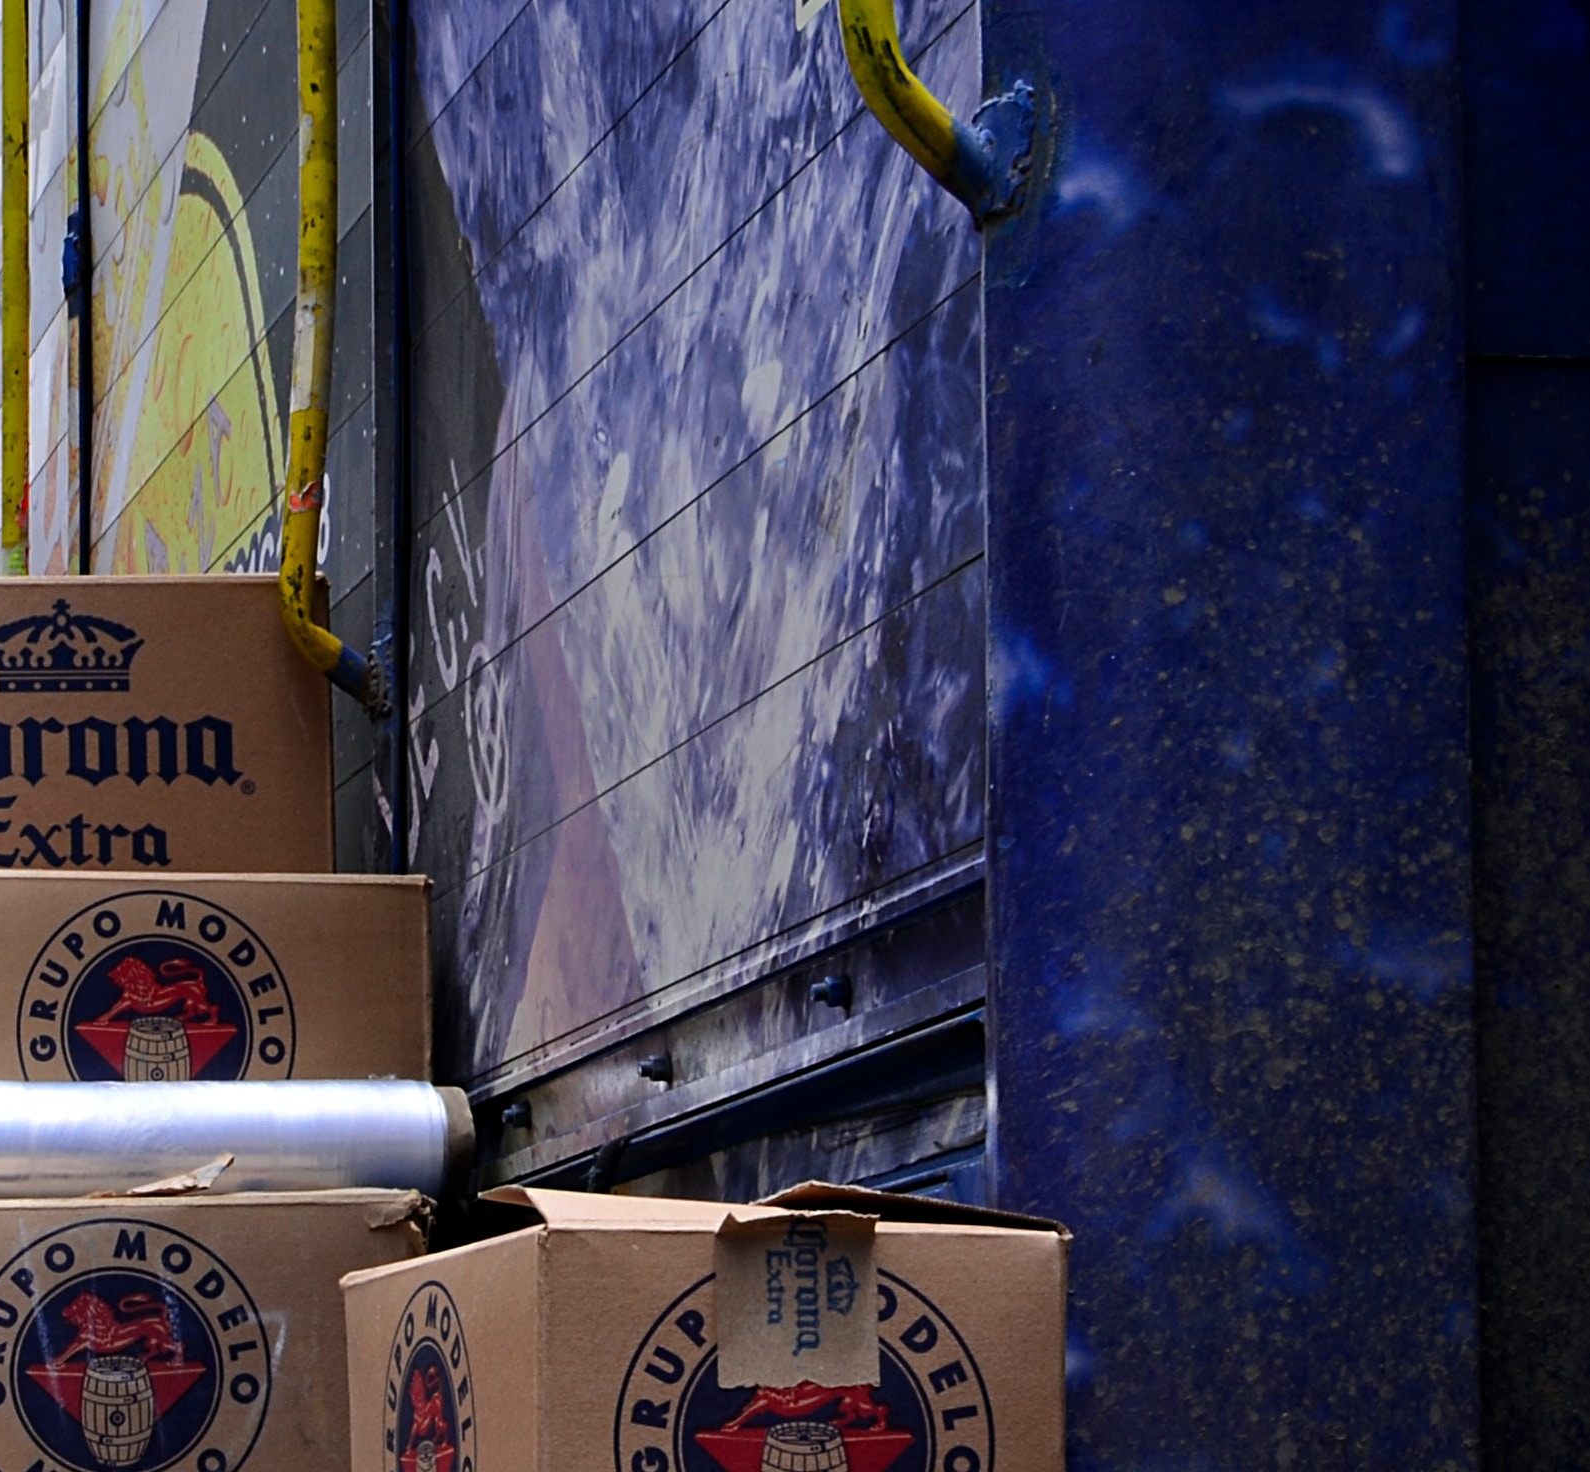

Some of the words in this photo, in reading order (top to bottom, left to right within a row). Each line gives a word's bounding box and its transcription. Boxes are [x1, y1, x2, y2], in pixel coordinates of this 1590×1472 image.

[29, 910, 122, 1063] GRUPO
[155, 900, 287, 1065] MODELO
[113, 1227, 260, 1405] MODELO
